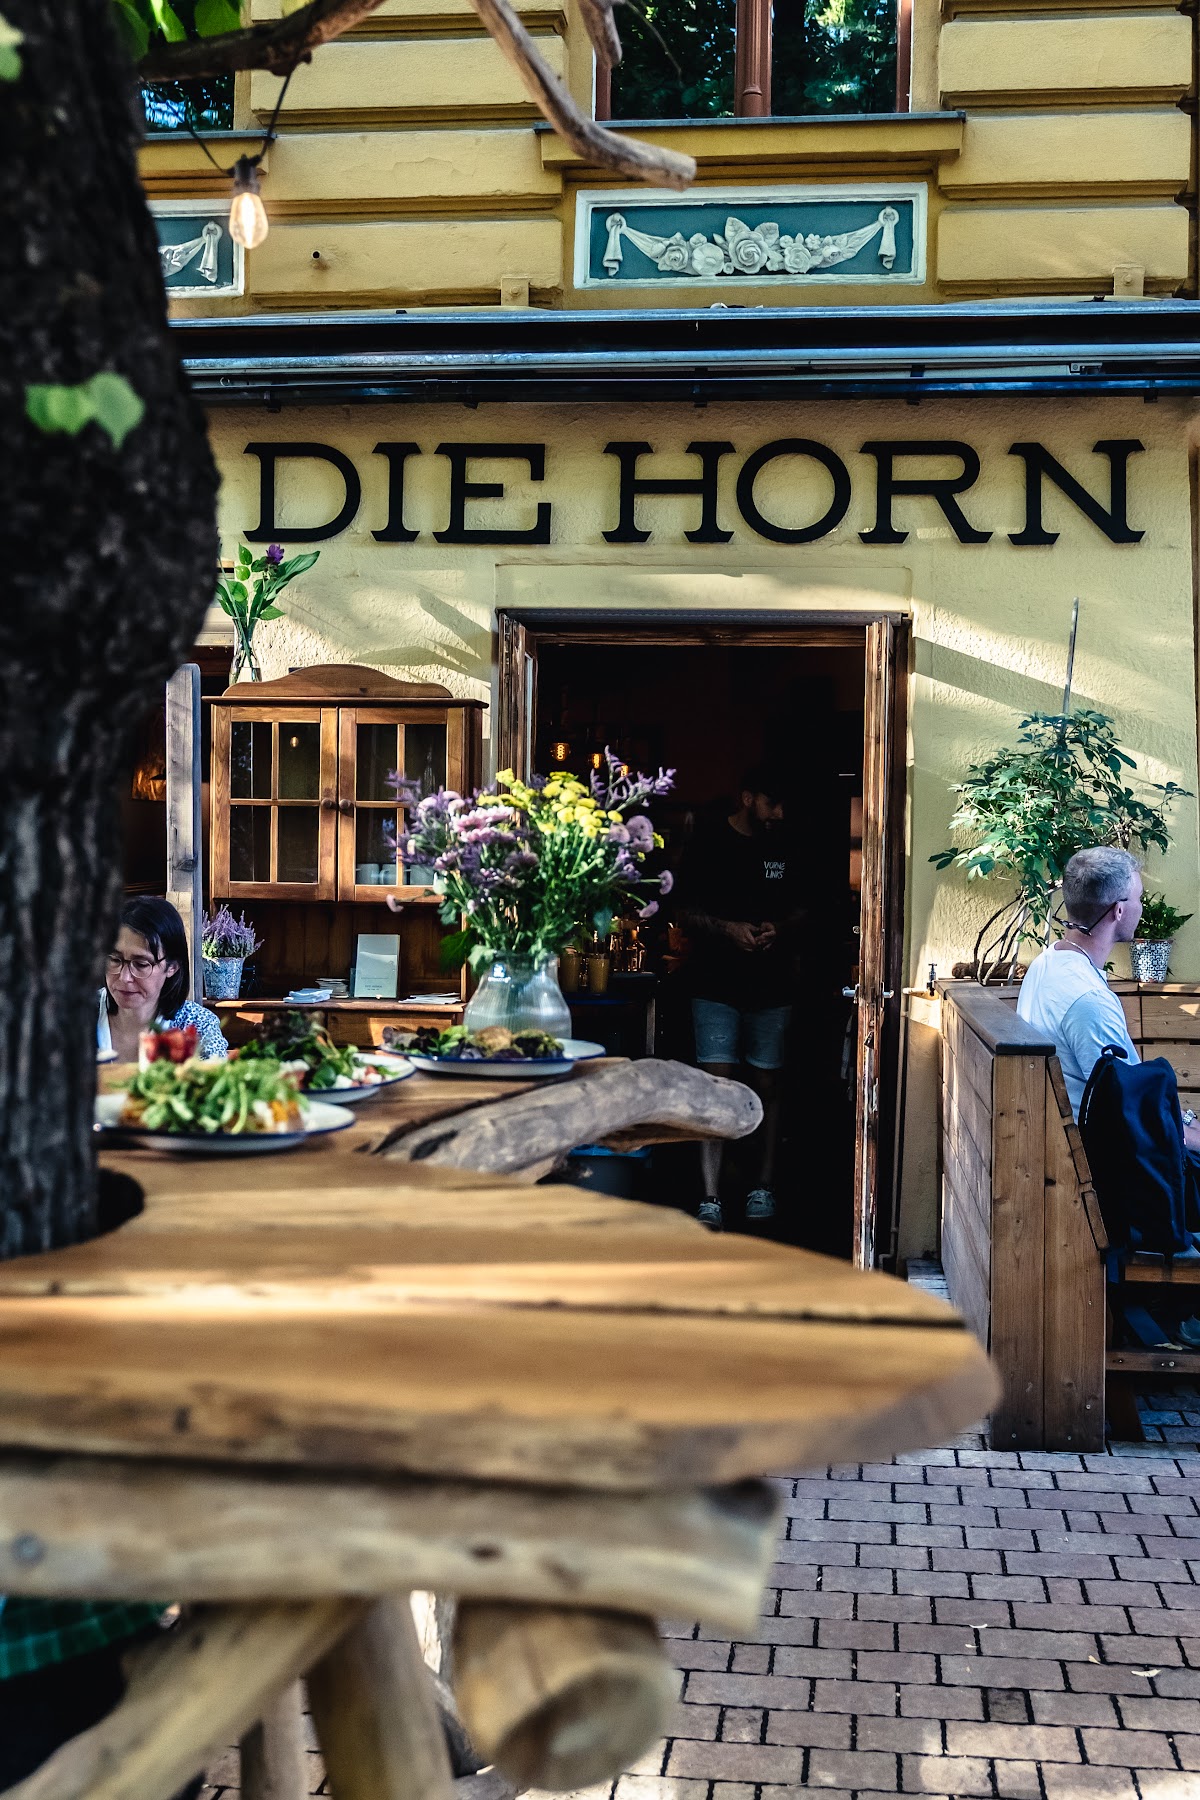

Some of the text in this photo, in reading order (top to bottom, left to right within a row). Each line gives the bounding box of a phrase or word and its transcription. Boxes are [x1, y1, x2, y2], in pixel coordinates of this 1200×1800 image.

[243, 437, 1146, 545] DIE HORN
[766, 869, 784, 879] LINKS
